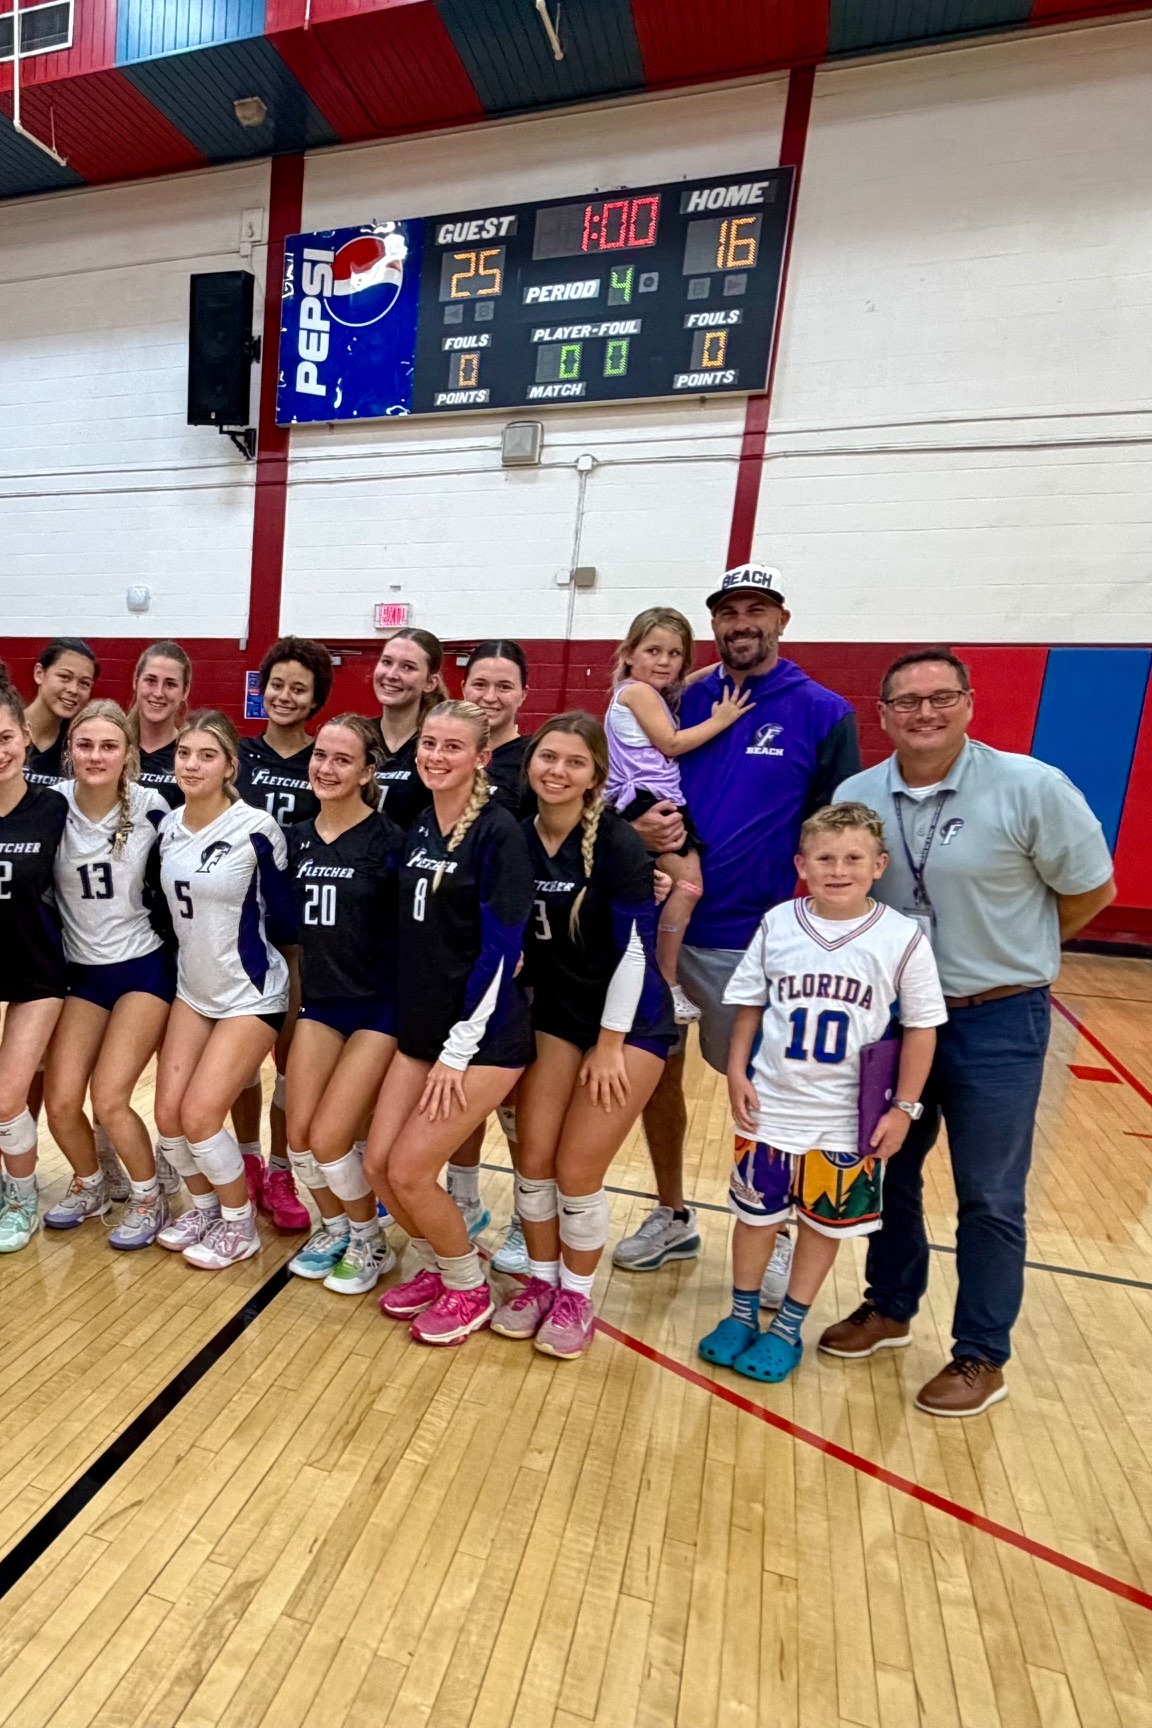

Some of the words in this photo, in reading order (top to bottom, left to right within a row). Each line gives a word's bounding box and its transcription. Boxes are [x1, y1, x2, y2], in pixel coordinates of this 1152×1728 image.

[686, 181, 770, 212] HOME
[437, 215, 516, 245] GUEST
[581, 196, 660, 252] 1:00
[716, 216, 757, 268] 16
[450, 249, 501, 299] 25
[525, 280, 598, 304] PERIOD
[611, 266, 634, 302] 4
[296, 248, 335, 397] PEPSI
[533, 320, 639, 342] PLAYER-FOUL
[686, 309, 740, 327] FOULS
[444, 334, 489, 350] FOULS
[558, 343, 581, 379] 0
[603, 340, 628, 376] 0
[701, 330, 727, 368] 0
[458, 353, 479, 387] 0
[676, 370, 736, 388] POINTS
[436, 390, 488, 405] POINTS
[529, 383, 584, 398] MATCH
[721, 569, 773, 589] BEACH
[745, 747, 784, 757] BEACH
[265, 792, 295, 828] 12
[77, 862, 115, 900] 13
[296, 861, 356, 879] FLETCHER
[174, 880, 194, 920] 5
[304, 884, 337, 926] 20
[413, 877, 428, 922] 8
[778, 973, 874, 1010] FLORIDA
[784, 1007, 850, 1065] 10
